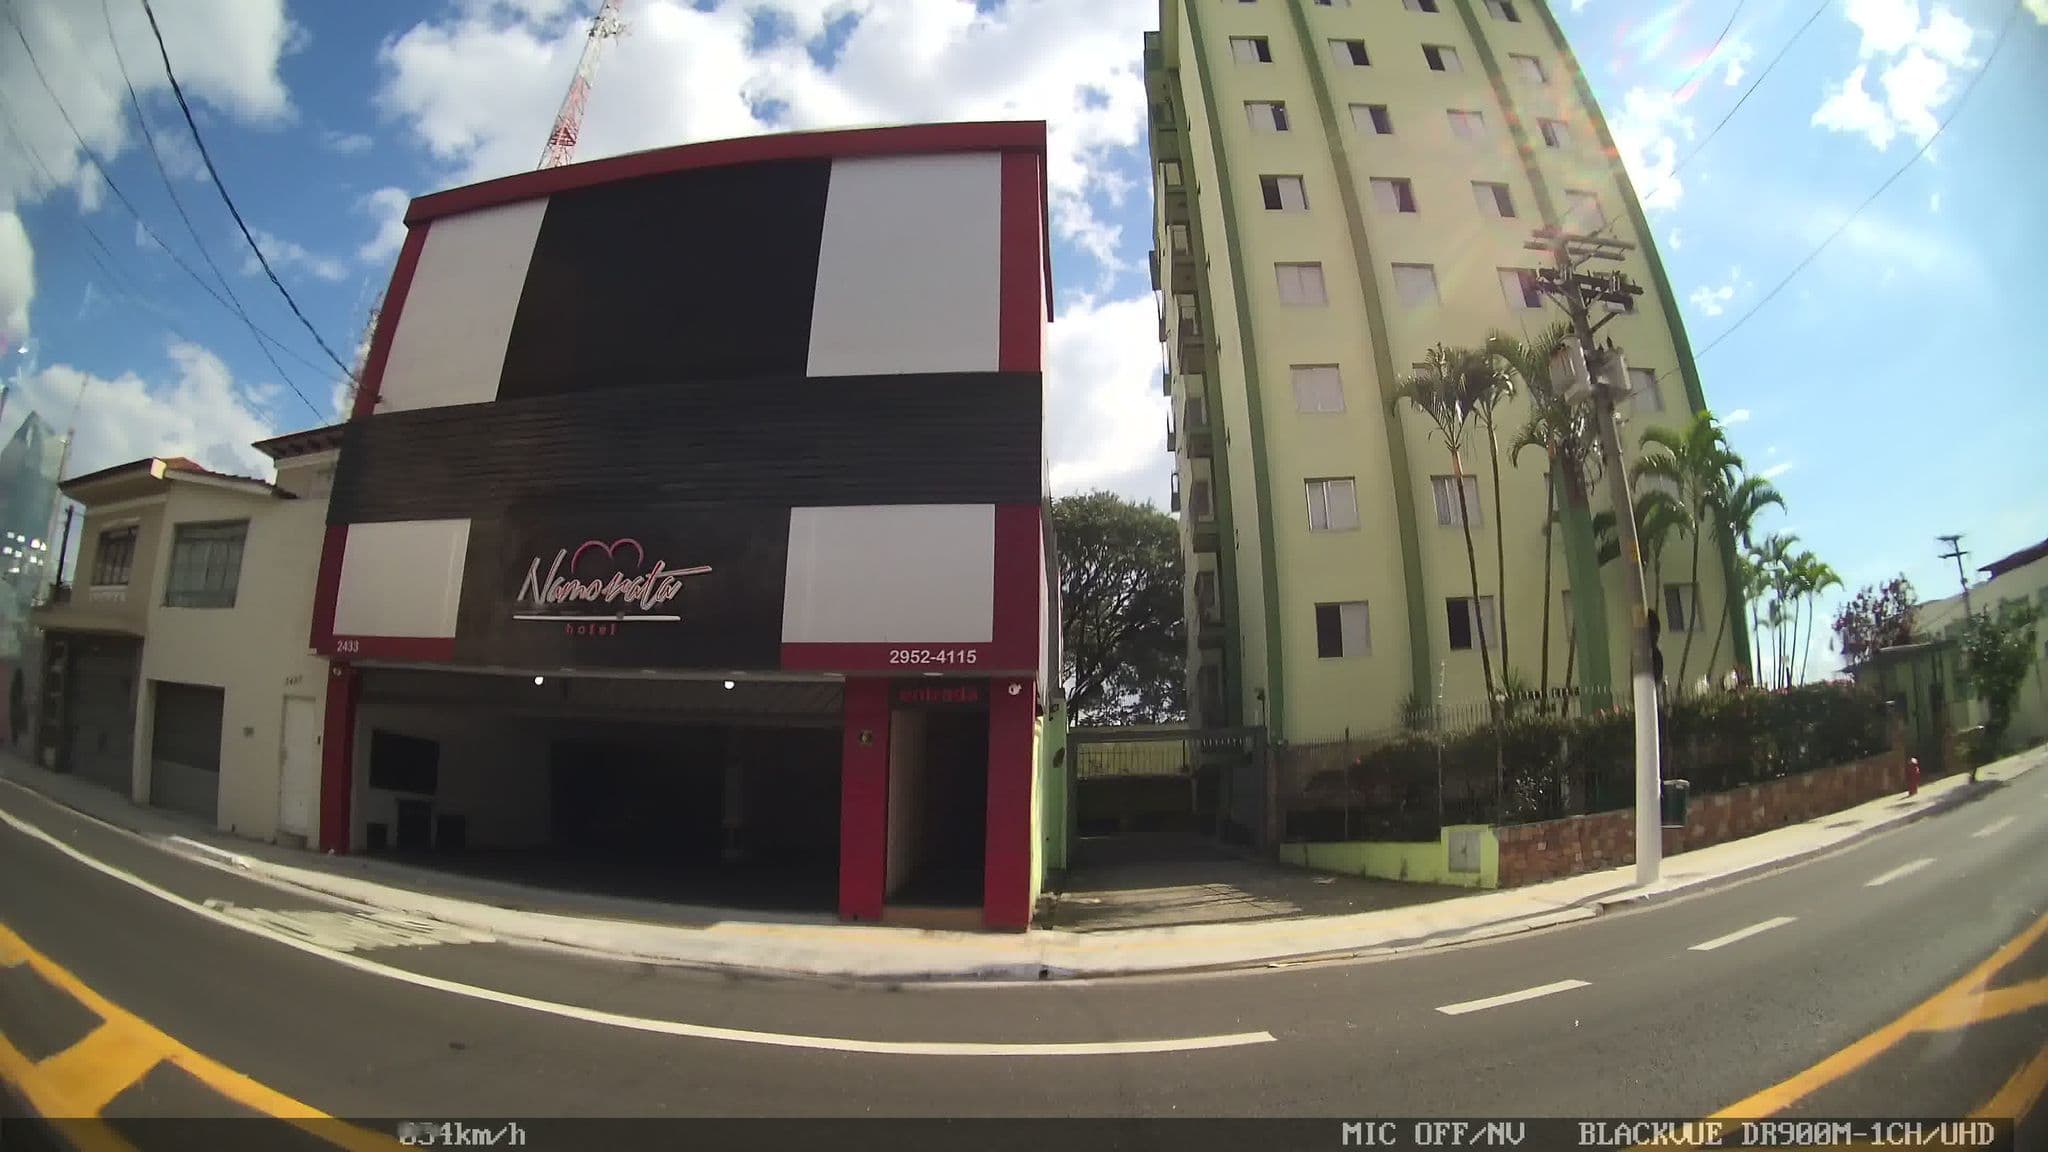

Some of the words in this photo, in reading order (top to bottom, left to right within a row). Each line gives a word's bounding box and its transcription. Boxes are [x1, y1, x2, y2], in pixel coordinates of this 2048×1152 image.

[564, 623, 617, 636] hotel
[336, 640, 360, 652] 2433
[889, 649, 978, 664] 2952-4115
